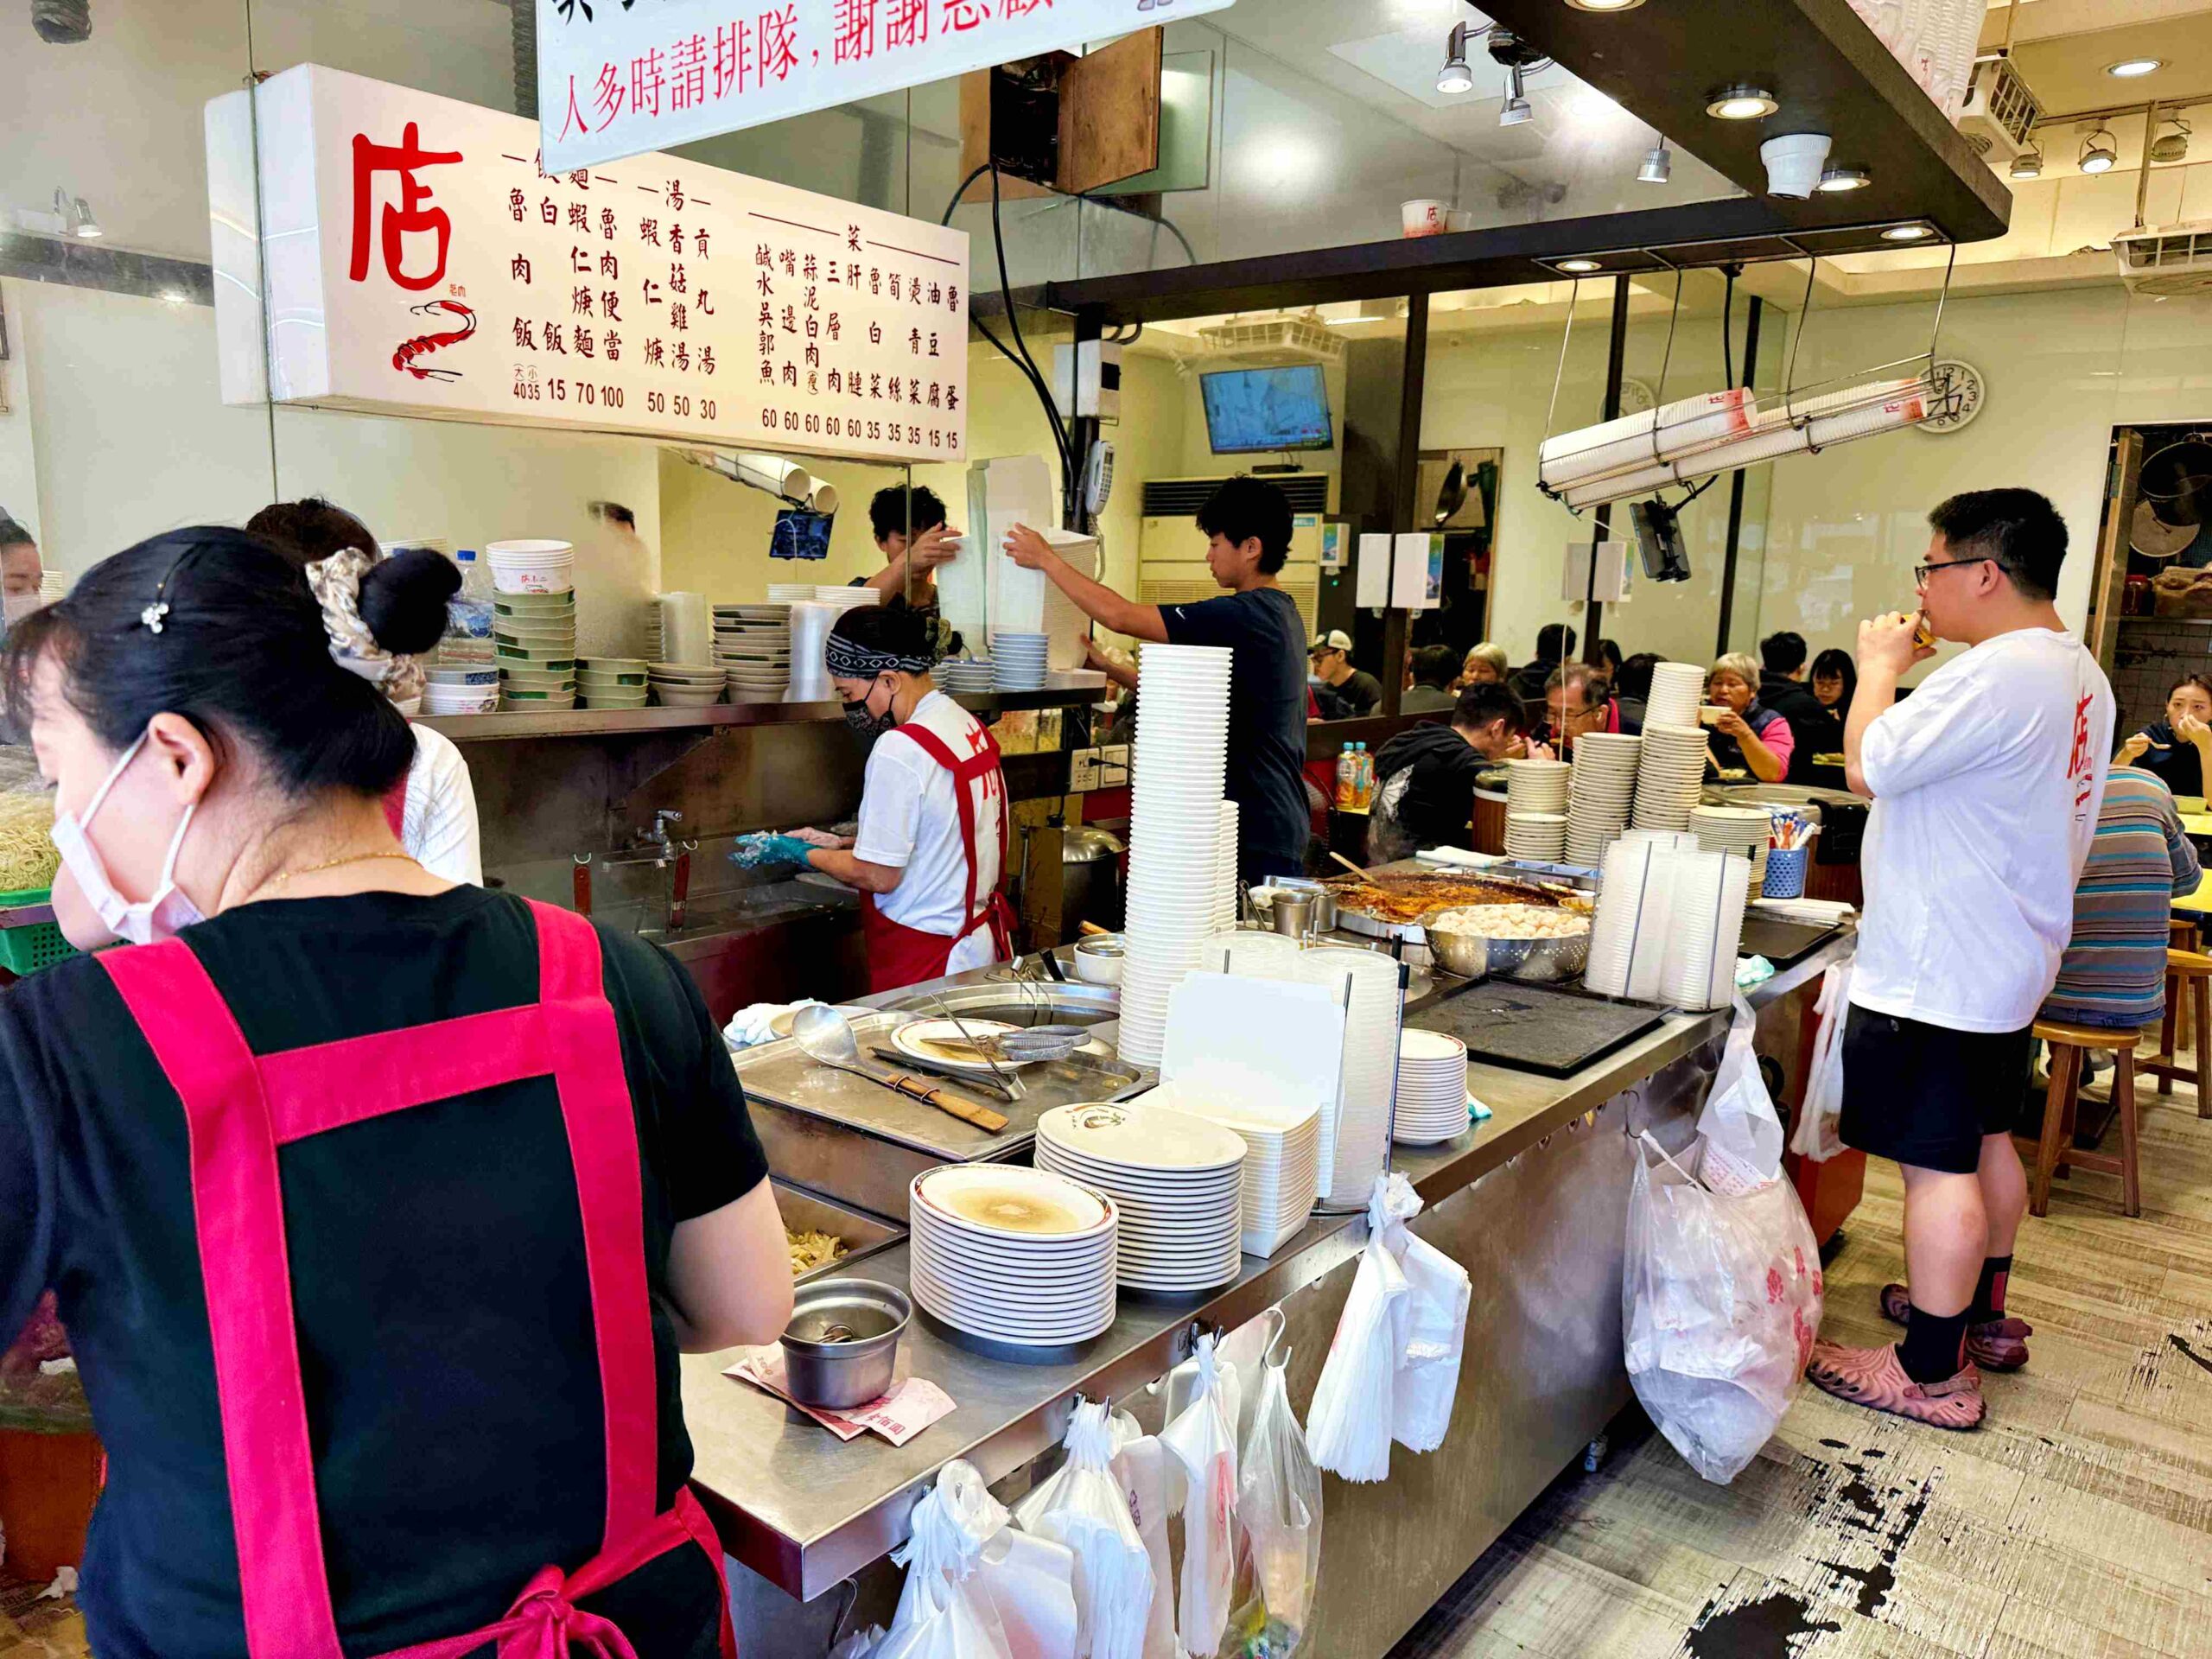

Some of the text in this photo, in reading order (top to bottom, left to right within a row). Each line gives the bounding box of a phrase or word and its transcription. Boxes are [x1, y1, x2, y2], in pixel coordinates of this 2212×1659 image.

[557, 0, 1053, 143] 人多時請排隊,謝謝
[349, 122, 463, 291] 店
[666, 180, 684, 211] 湯
[848, 224, 862, 251] 菜
[509, 188, 537, 351] 魯肉飯
[600, 207, 623, 408] 魯肉便當 100
[669, 224, 690, 416] 香菇雞湯 50
[694, 228, 715, 420] 貢丸湯 30
[779, 249, 798, 430] 嘴邊肉 60
[826, 261, 841, 435] 三層肉 60
[868, 267, 883, 440] 魯白菜 35
[927, 282, 941, 447] 油豆腐 15
[945, 285, 959, 448] 魯蛋 15
[514, 383, 526, 398] 40
[528, 384, 540, 400] 35
[548, 378, 566, 401] 15
[575, 382, 594, 404] 70
[648, 391, 664, 413] 50
[762, 409, 777, 428] 60
[805, 414, 819, 433] 60
[848, 419, 861, 438] 60
[888, 423, 900, 442] 35
[908, 426, 920, 444] 35
